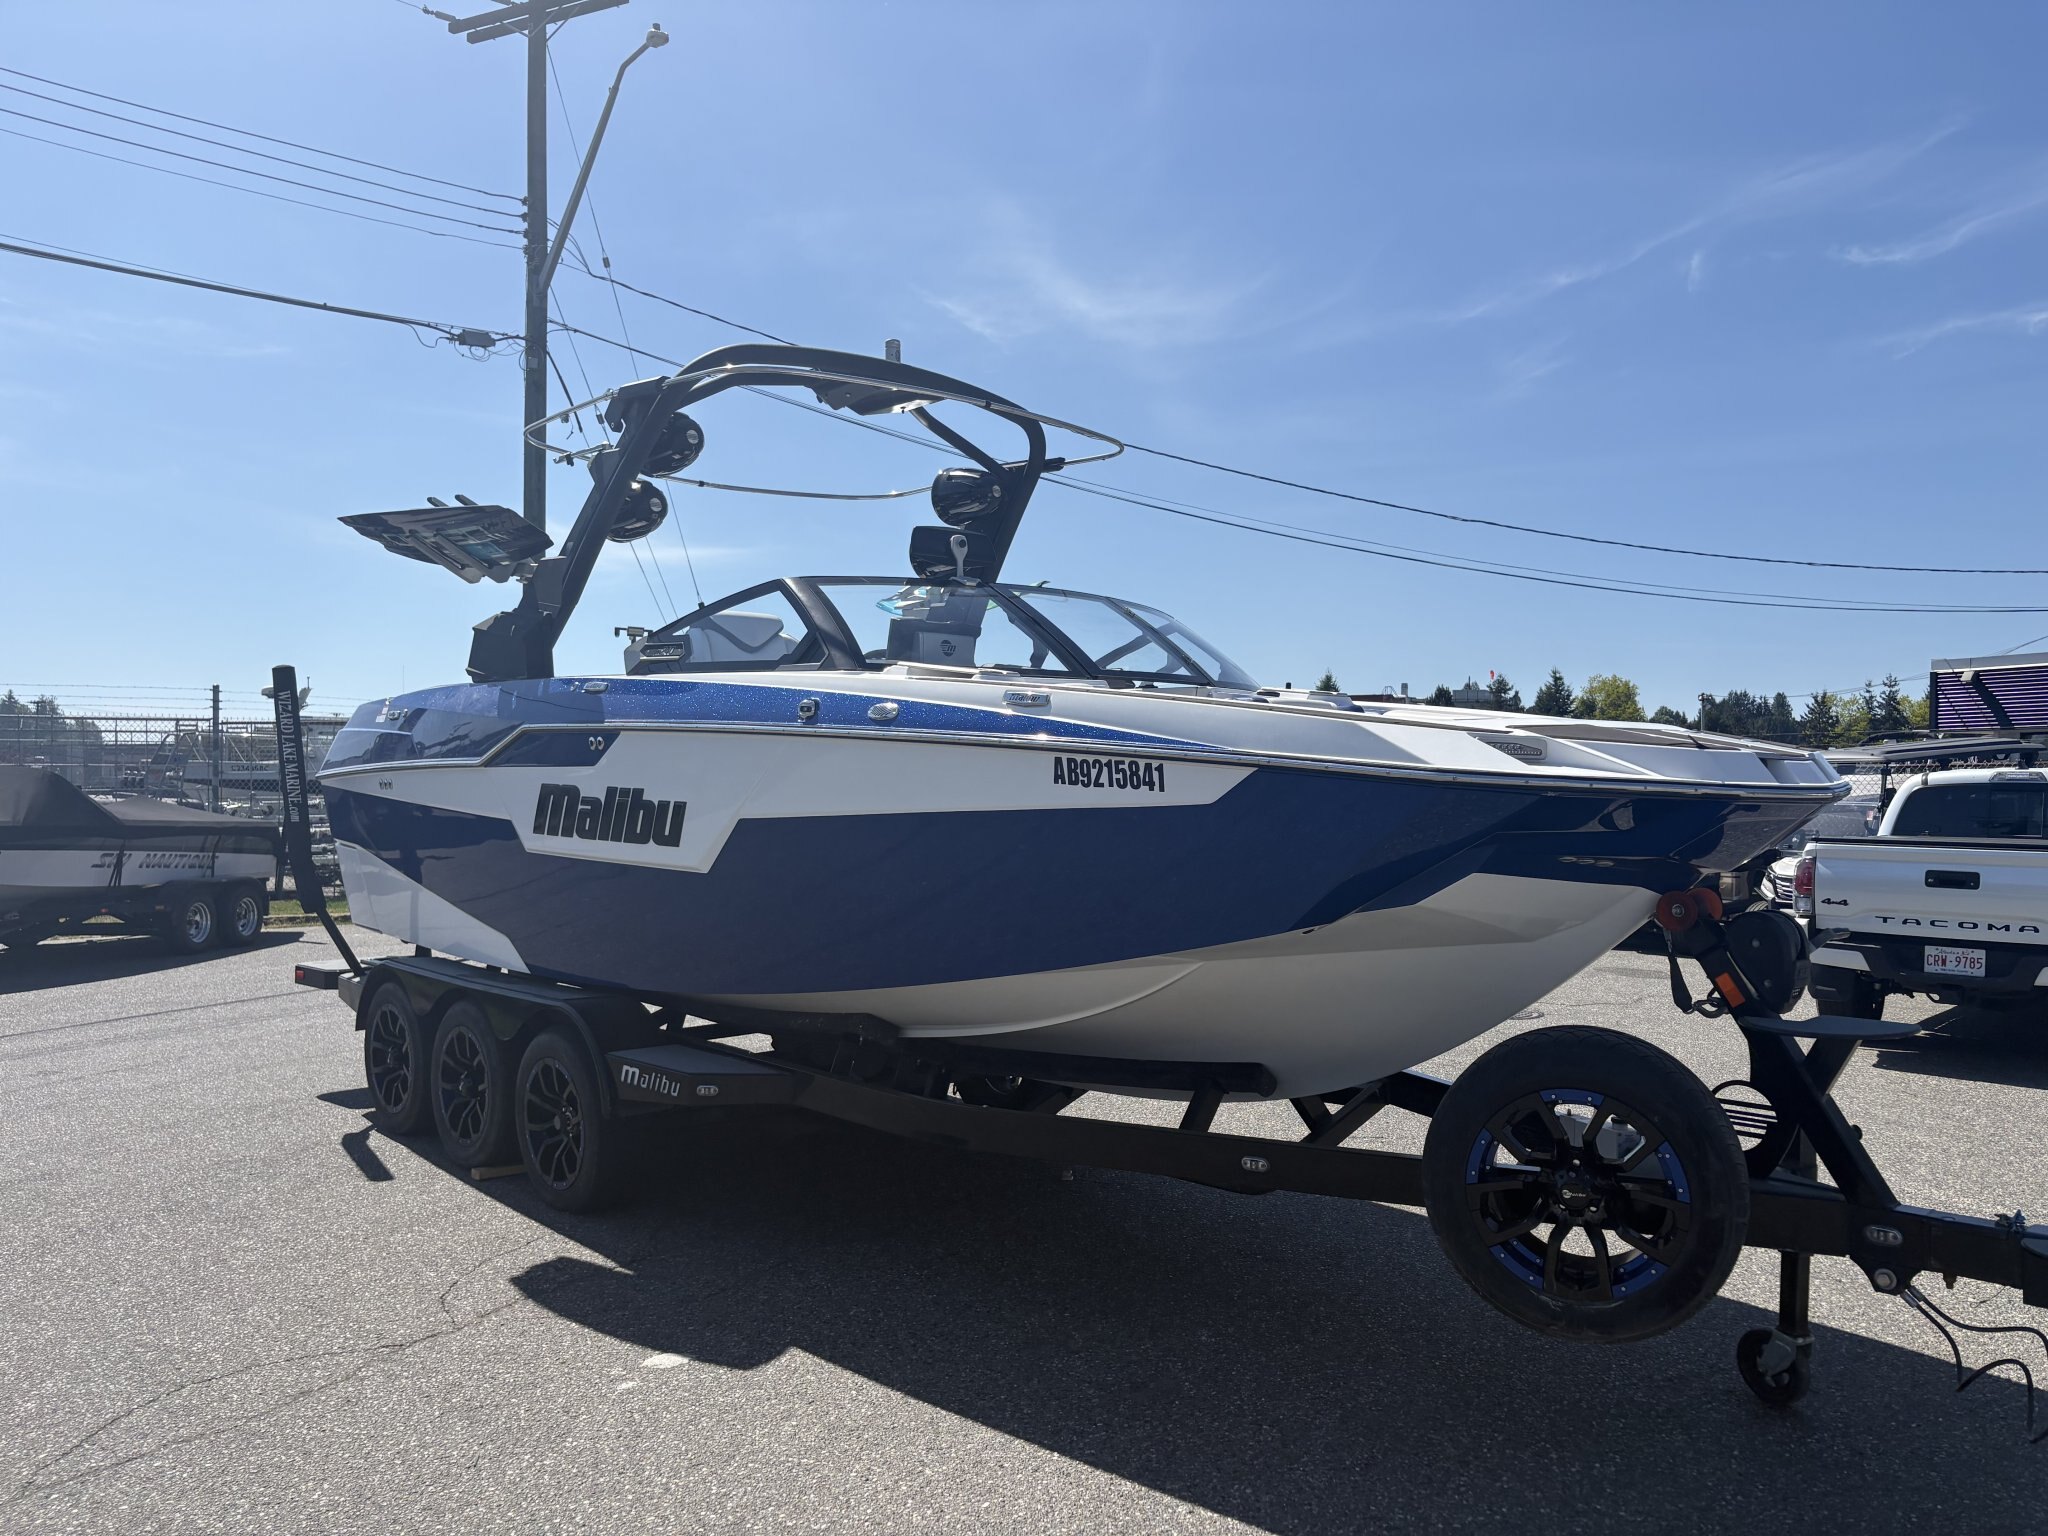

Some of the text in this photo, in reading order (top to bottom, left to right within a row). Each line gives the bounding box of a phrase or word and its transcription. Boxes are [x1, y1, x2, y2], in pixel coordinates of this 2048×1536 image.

[277, 690, 302, 822] WIZARD LAKE MARINE.com
[1053, 756, 1165, 793] AB9215841
[1874, 915, 2040, 934] TACOMA
[1926, 953, 1983, 970] CRW-9785
